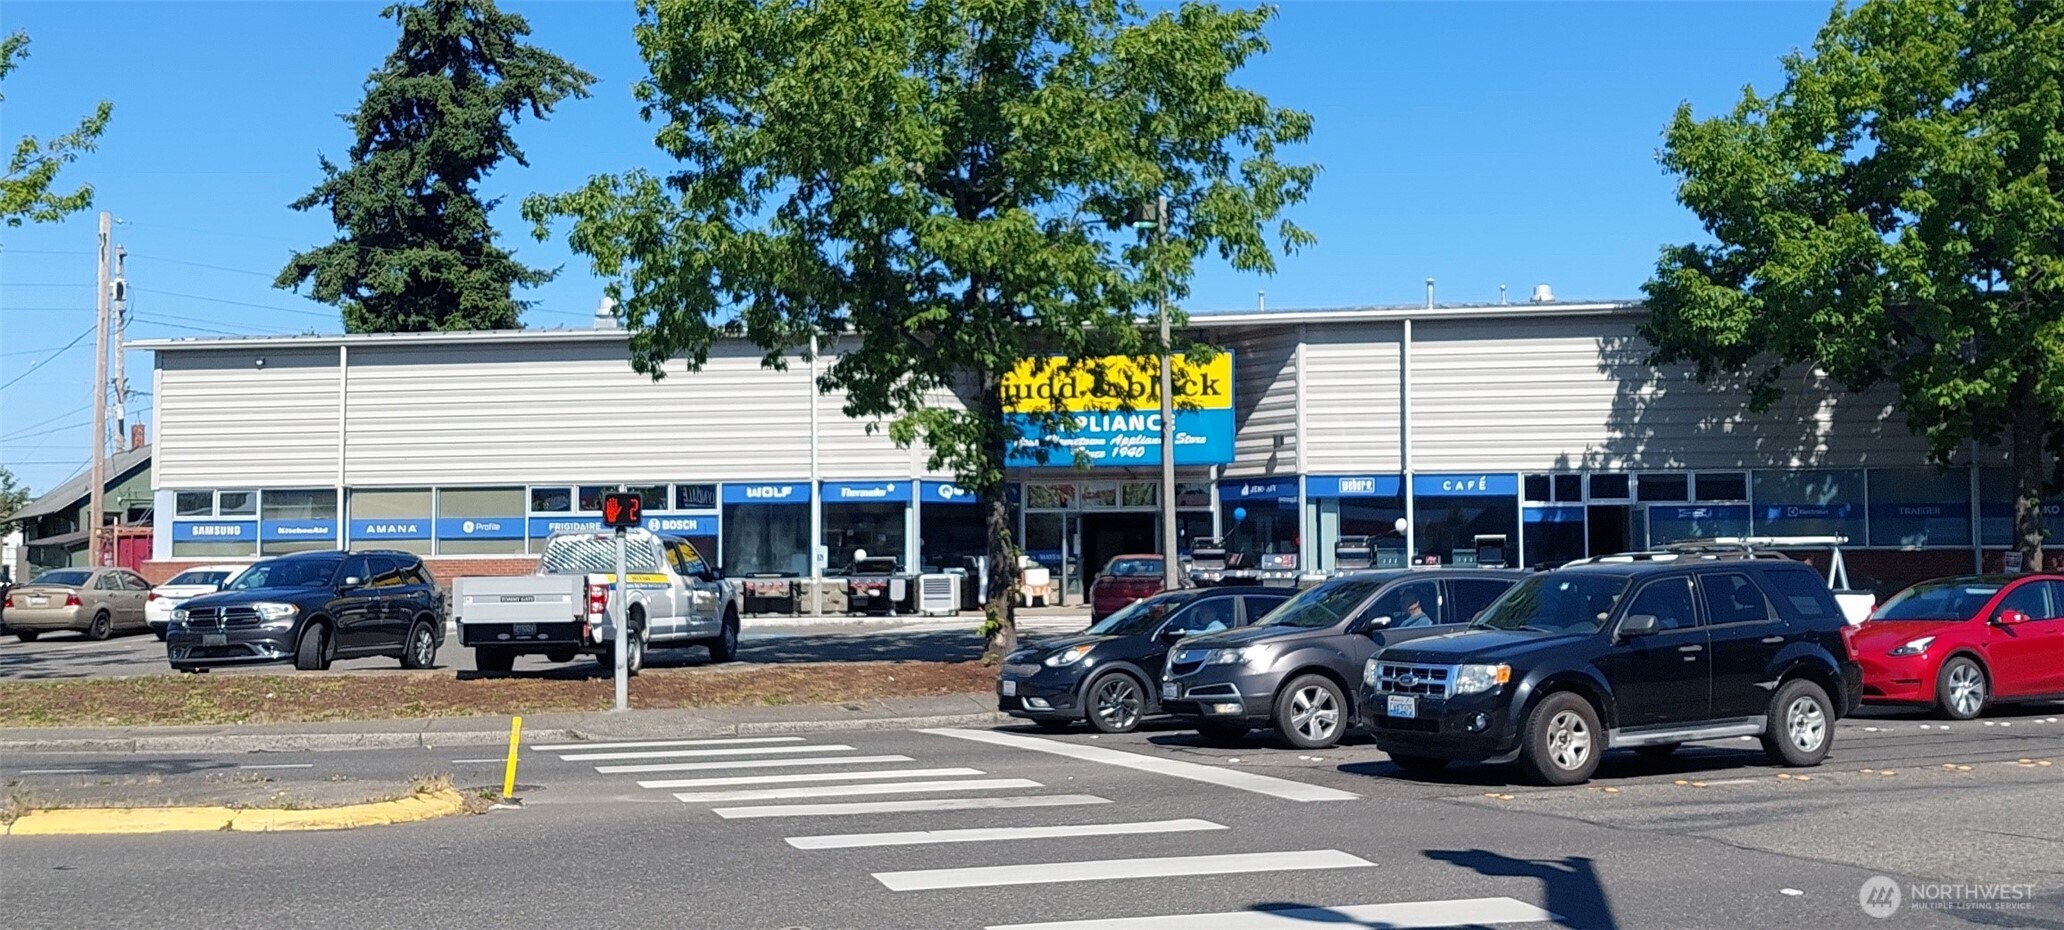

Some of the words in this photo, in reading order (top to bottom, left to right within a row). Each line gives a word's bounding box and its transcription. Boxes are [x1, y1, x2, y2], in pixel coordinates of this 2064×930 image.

[1126, 370, 1222, 397] blck
[1174, 432, 1207, 445] Store
[1442, 475, 1487, 490] CAFÉ
[746, 486, 792, 498] WOLF
[629, 498, 639, 521] 2
[1899, 506, 1941, 516] TRAEGER
[366, 524, 417, 534] AMANA
[475, 522, 501, 531] Profile
[549, 522, 601, 531] FRIGIDAIRE
[662, 519, 698, 530] BOSCH
[192, 525, 241, 536] SAMSUNG
